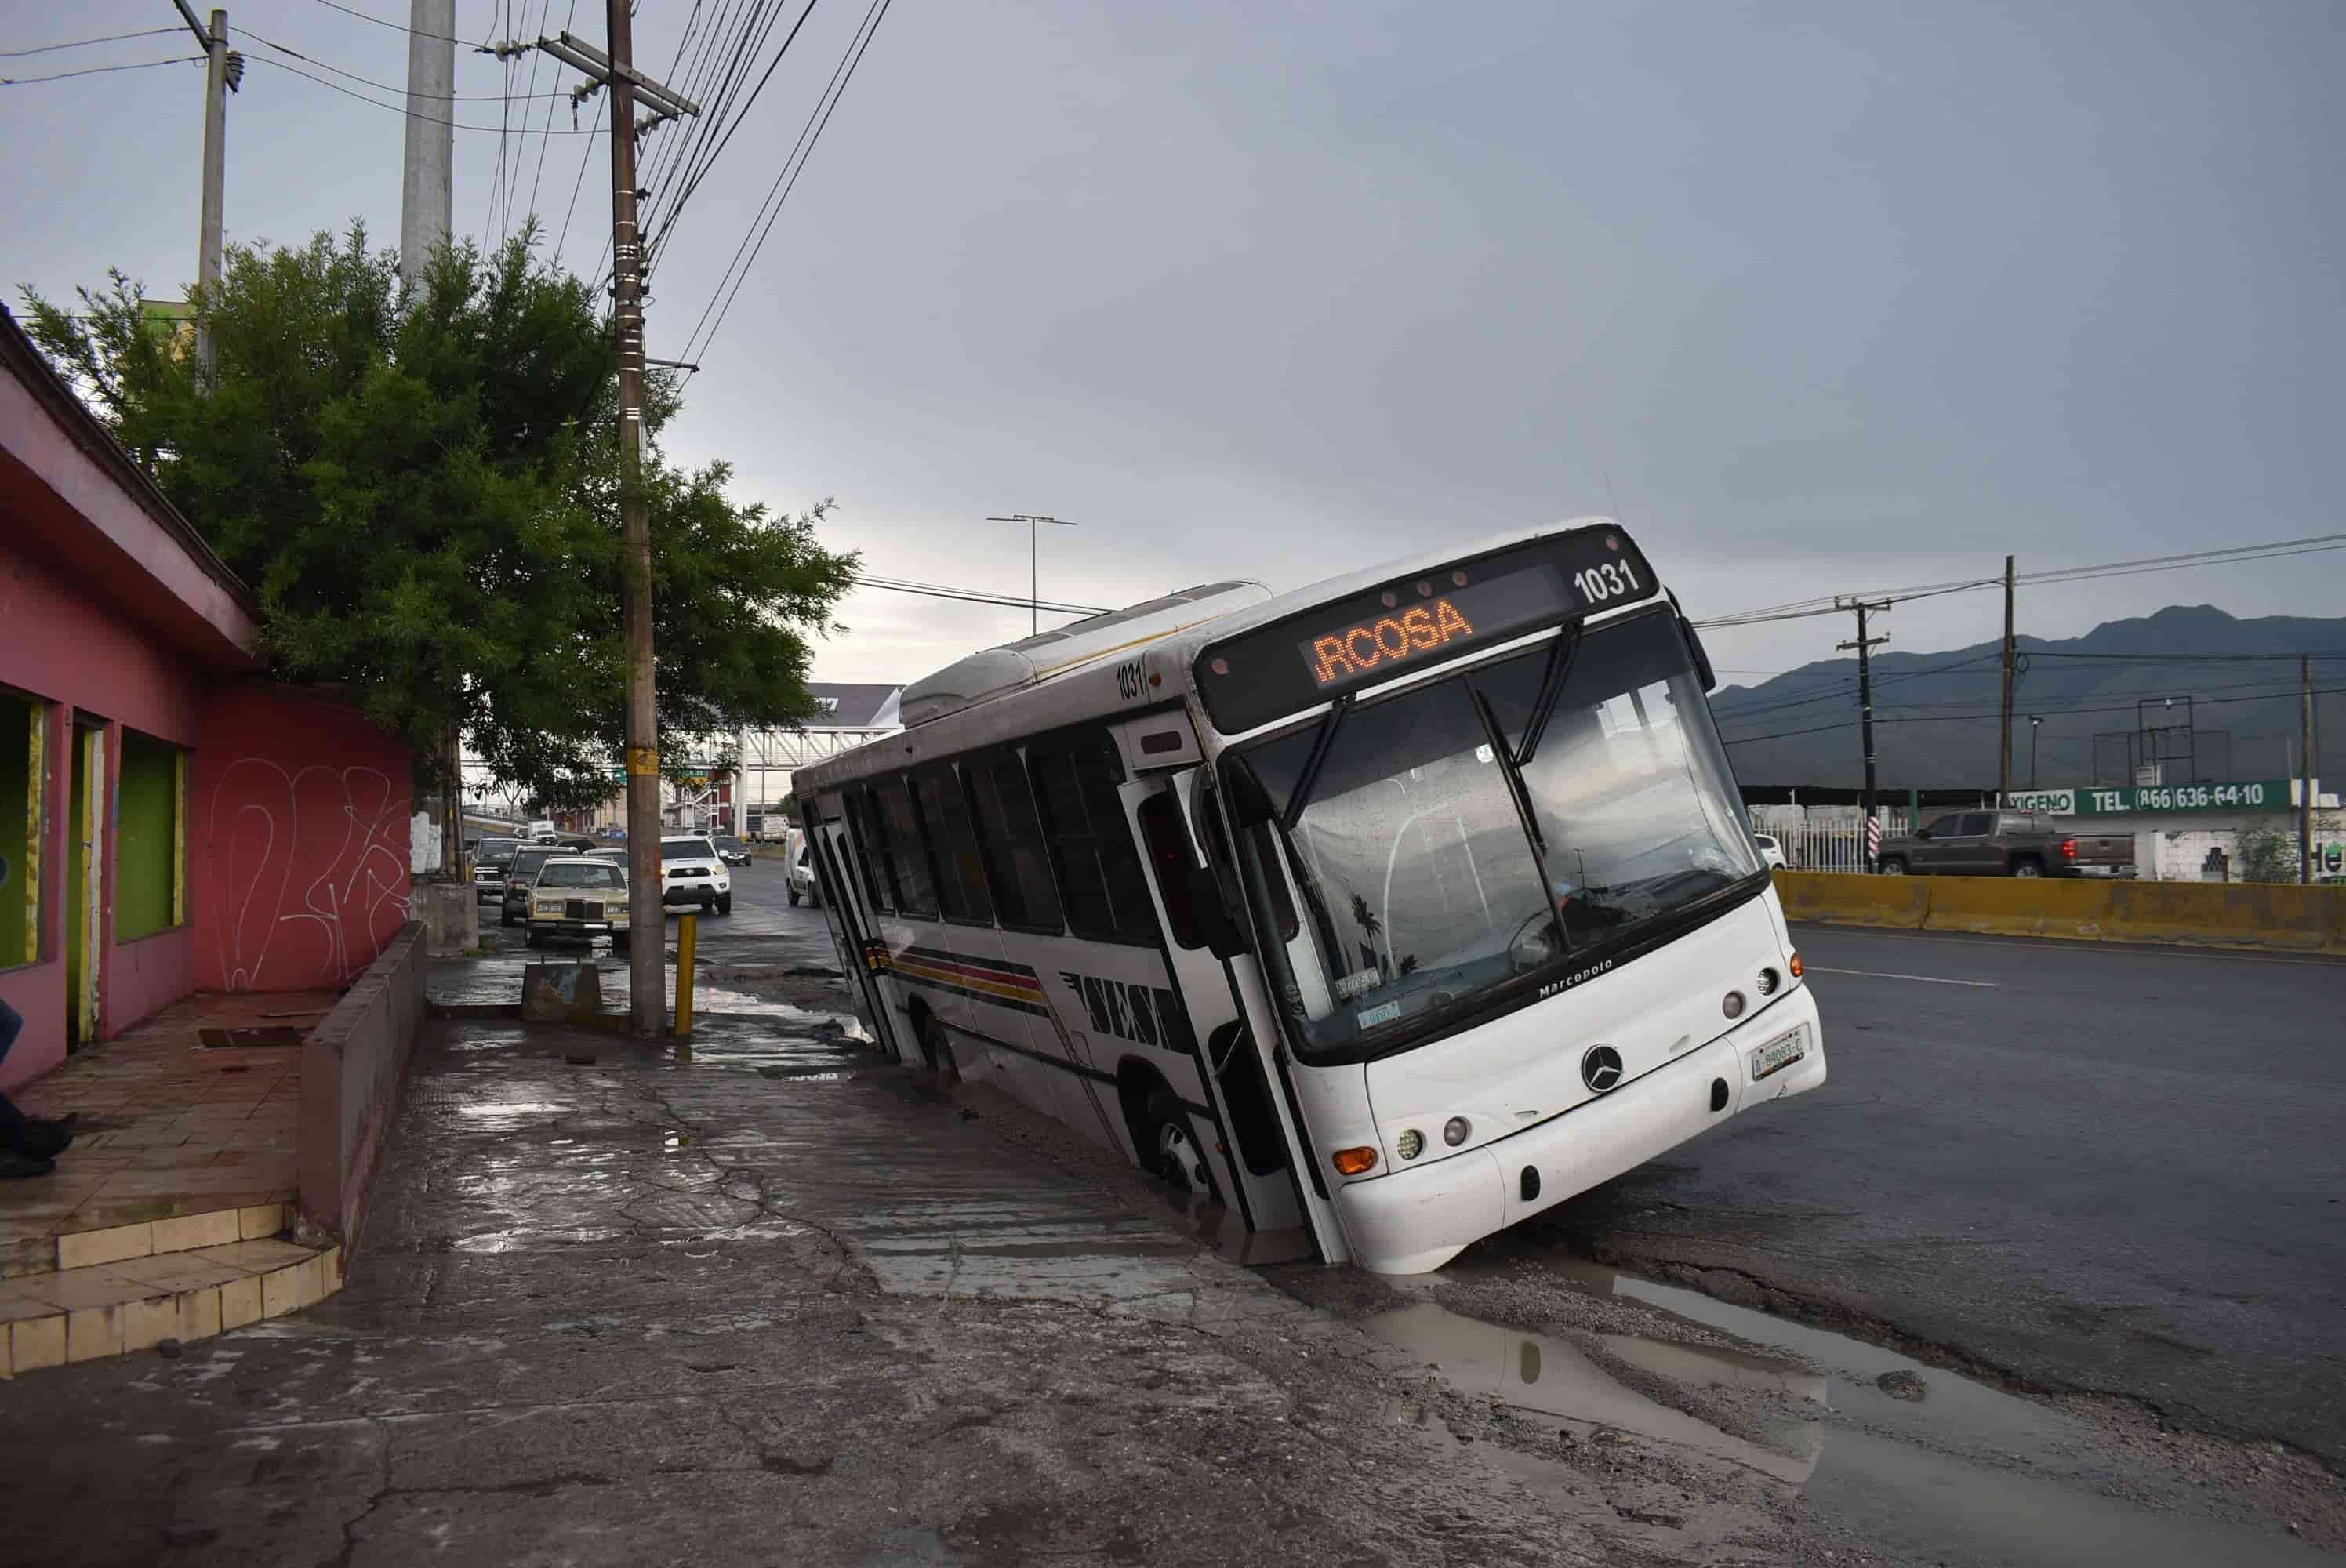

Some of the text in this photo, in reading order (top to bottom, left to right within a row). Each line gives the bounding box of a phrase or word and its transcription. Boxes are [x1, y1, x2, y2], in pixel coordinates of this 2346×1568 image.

[1574, 558, 1640, 604] 1031
[1116, 660, 1144, 701] 1031
[2092, 791, 2131, 812] TEL.
[1538, 959, 1613, 998] Marcopolo
